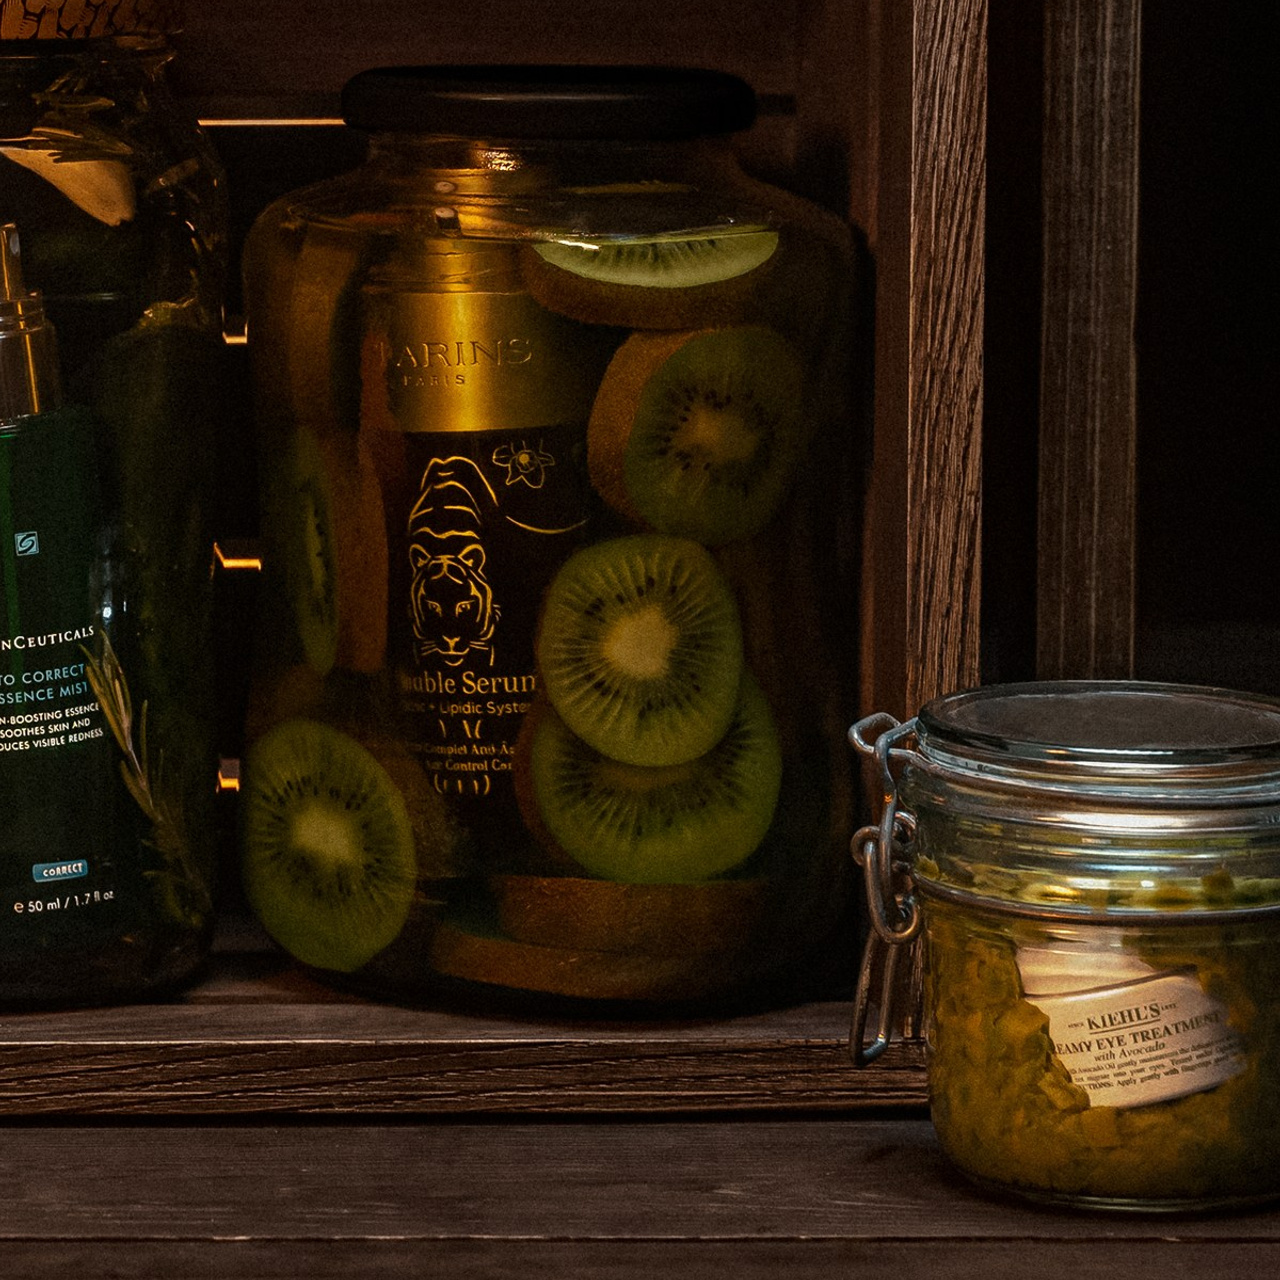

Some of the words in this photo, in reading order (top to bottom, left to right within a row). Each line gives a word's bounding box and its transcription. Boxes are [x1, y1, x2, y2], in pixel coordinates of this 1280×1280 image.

[380, 338, 533, 368] ARINS
[402, 375, 466, 387] PARIS
[22, 663, 84, 684] CORRECT
[412, 670, 457, 694] uble
[59, 681, 88, 697] MIST
[486, 700, 531, 716] Syste
[0, 725, 45, 739] SOOTHES
[48, 721, 69, 734] SKIN
[72, 717, 91, 729] AND
[32, 735, 66, 749] VISIBLE
[68, 728, 104, 744] REDNESS
[42, 862, 83, 877] CORRECT
[28, 900, 43, 913] 50
[46, 897, 61, 910] ml
[64, 896, 71, 909] /
[74, 892, 91, 907] 1.7
[93, 890, 101, 902] fl
[103, 890, 115, 901] oz
[1086, 1002, 1161, 1030] KIEHL'S
[1053, 1040, 1092, 1055] EAMY
[1095, 1034, 1128, 1051] EYE
[1129, 1010, 1222, 1044] TREATMENT
[1094, 1049, 1116, 1062] with
[1119, 1041, 1166, 1059] Avocado
